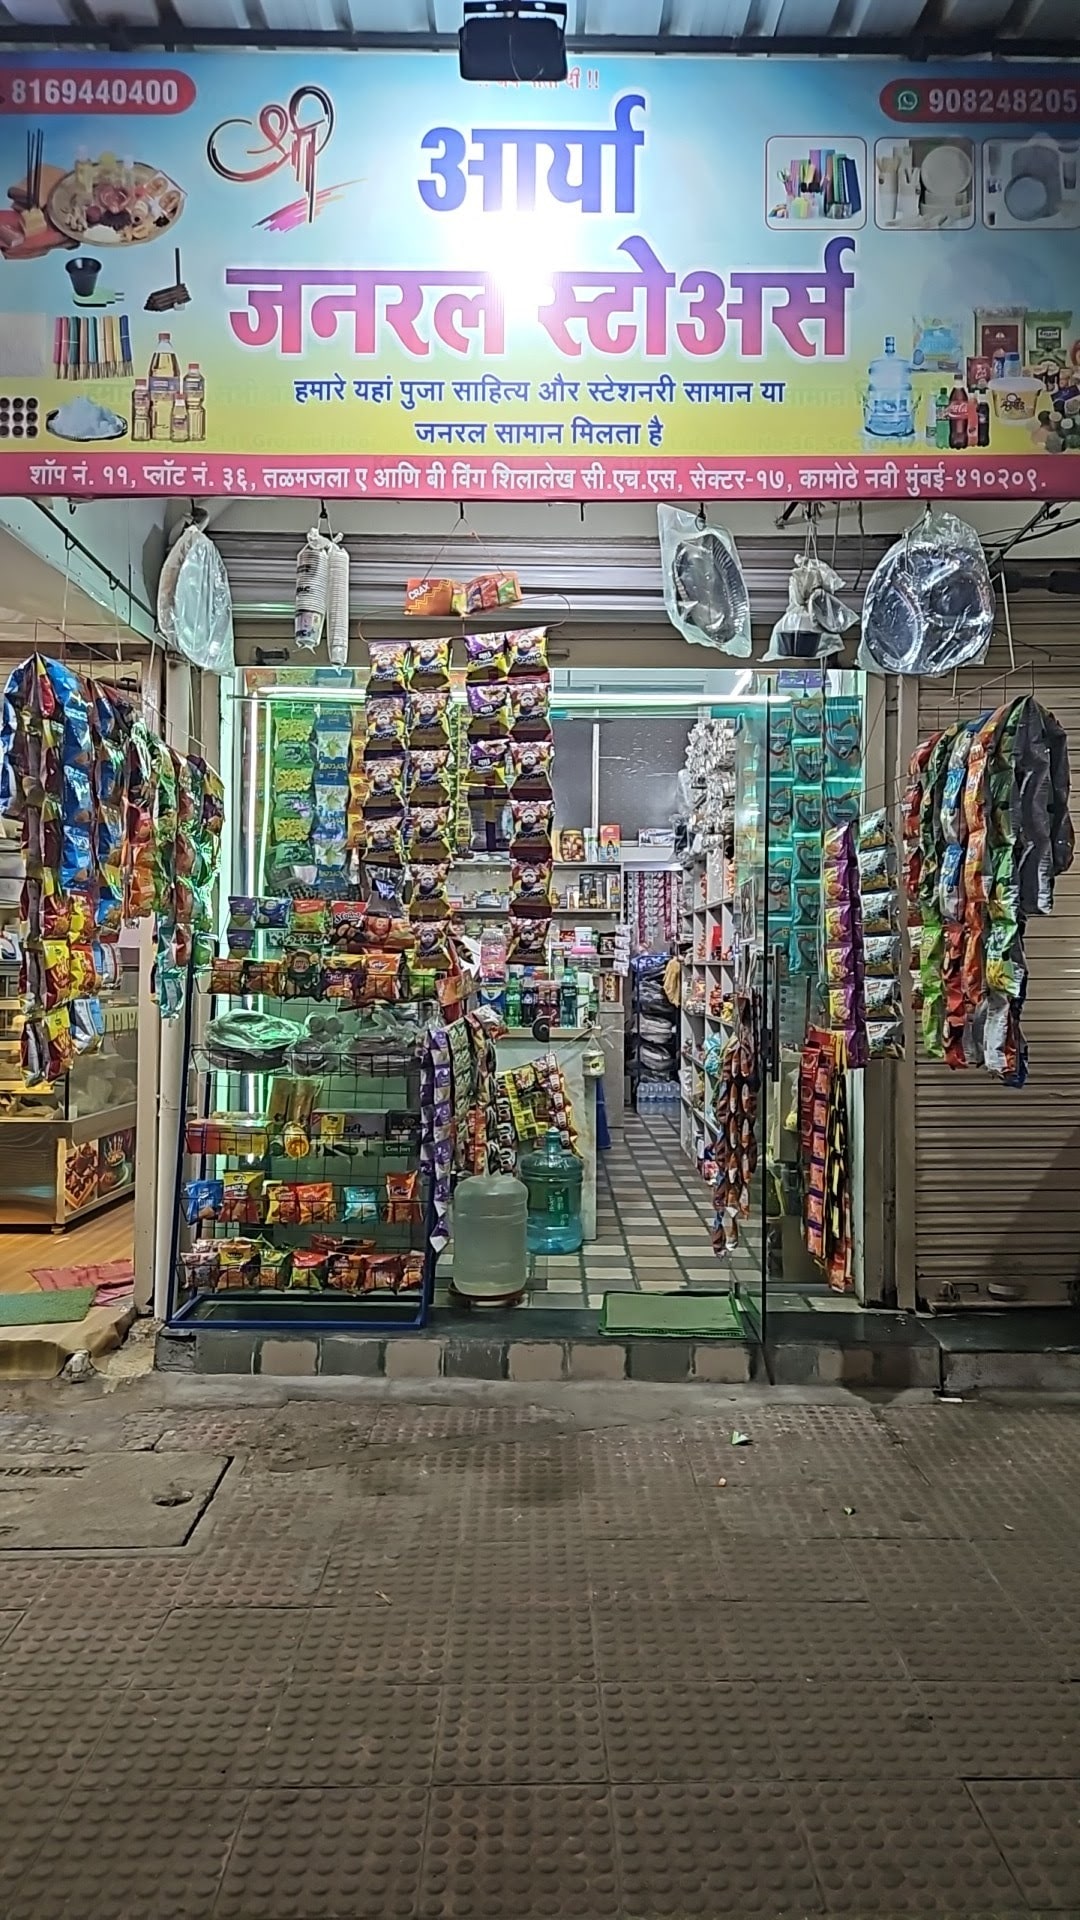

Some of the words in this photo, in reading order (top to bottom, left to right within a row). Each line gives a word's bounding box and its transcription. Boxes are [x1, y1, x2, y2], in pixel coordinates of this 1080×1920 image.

[12, 78, 178, 105] 8169440400
[417, 94, 646, 214] आर्या
[226, 268, 505, 355] जनरल
[538, 235, 855, 357] स्टोअर्स
[294, 374, 346, 403] हमारे
[353, 376, 393, 403] यहां
[400, 381, 445, 410] पुजा
[452, 374, 530, 404] साहित्य
[538, 373, 580, 402] और
[587, 374, 676, 403] स्टेशनरी
[683, 381, 753, 403] सामान
[760, 382, 786, 403] या
[414, 423, 487, 444] जनरल
[494, 423, 564, 444] सामान
[571, 416, 641, 445] मिलता
[648, 415, 663, 447] है
[30, 459, 66, 485] शॉप
[72, 461, 95, 486] नं.
[103, 465, 136, 489] ११,
[143, 459, 187, 487] प्लॉट
[192, 461, 214, 487] नं.
[222, 467, 256, 491] ३६,
[263, 468, 350, 489] तळमजला
[355, 468, 369, 491] ए
[373, 461, 422, 489] आणि
[426, 461, 446, 489] बी
[452, 461, 487, 489] विंग
[492, 461, 576, 490] शिलालेख
[581, 462, 683, 493] सी.एच.एस,
[689, 463, 793, 493] सेक्टर-१७,
[799, 462, 858, 490] कामोठे
[864, 461, 899, 489] नवी
[905, 461, 1046, 497] मुंबई-४१०२०९.
[407, 581, 431, 601] CRAX
